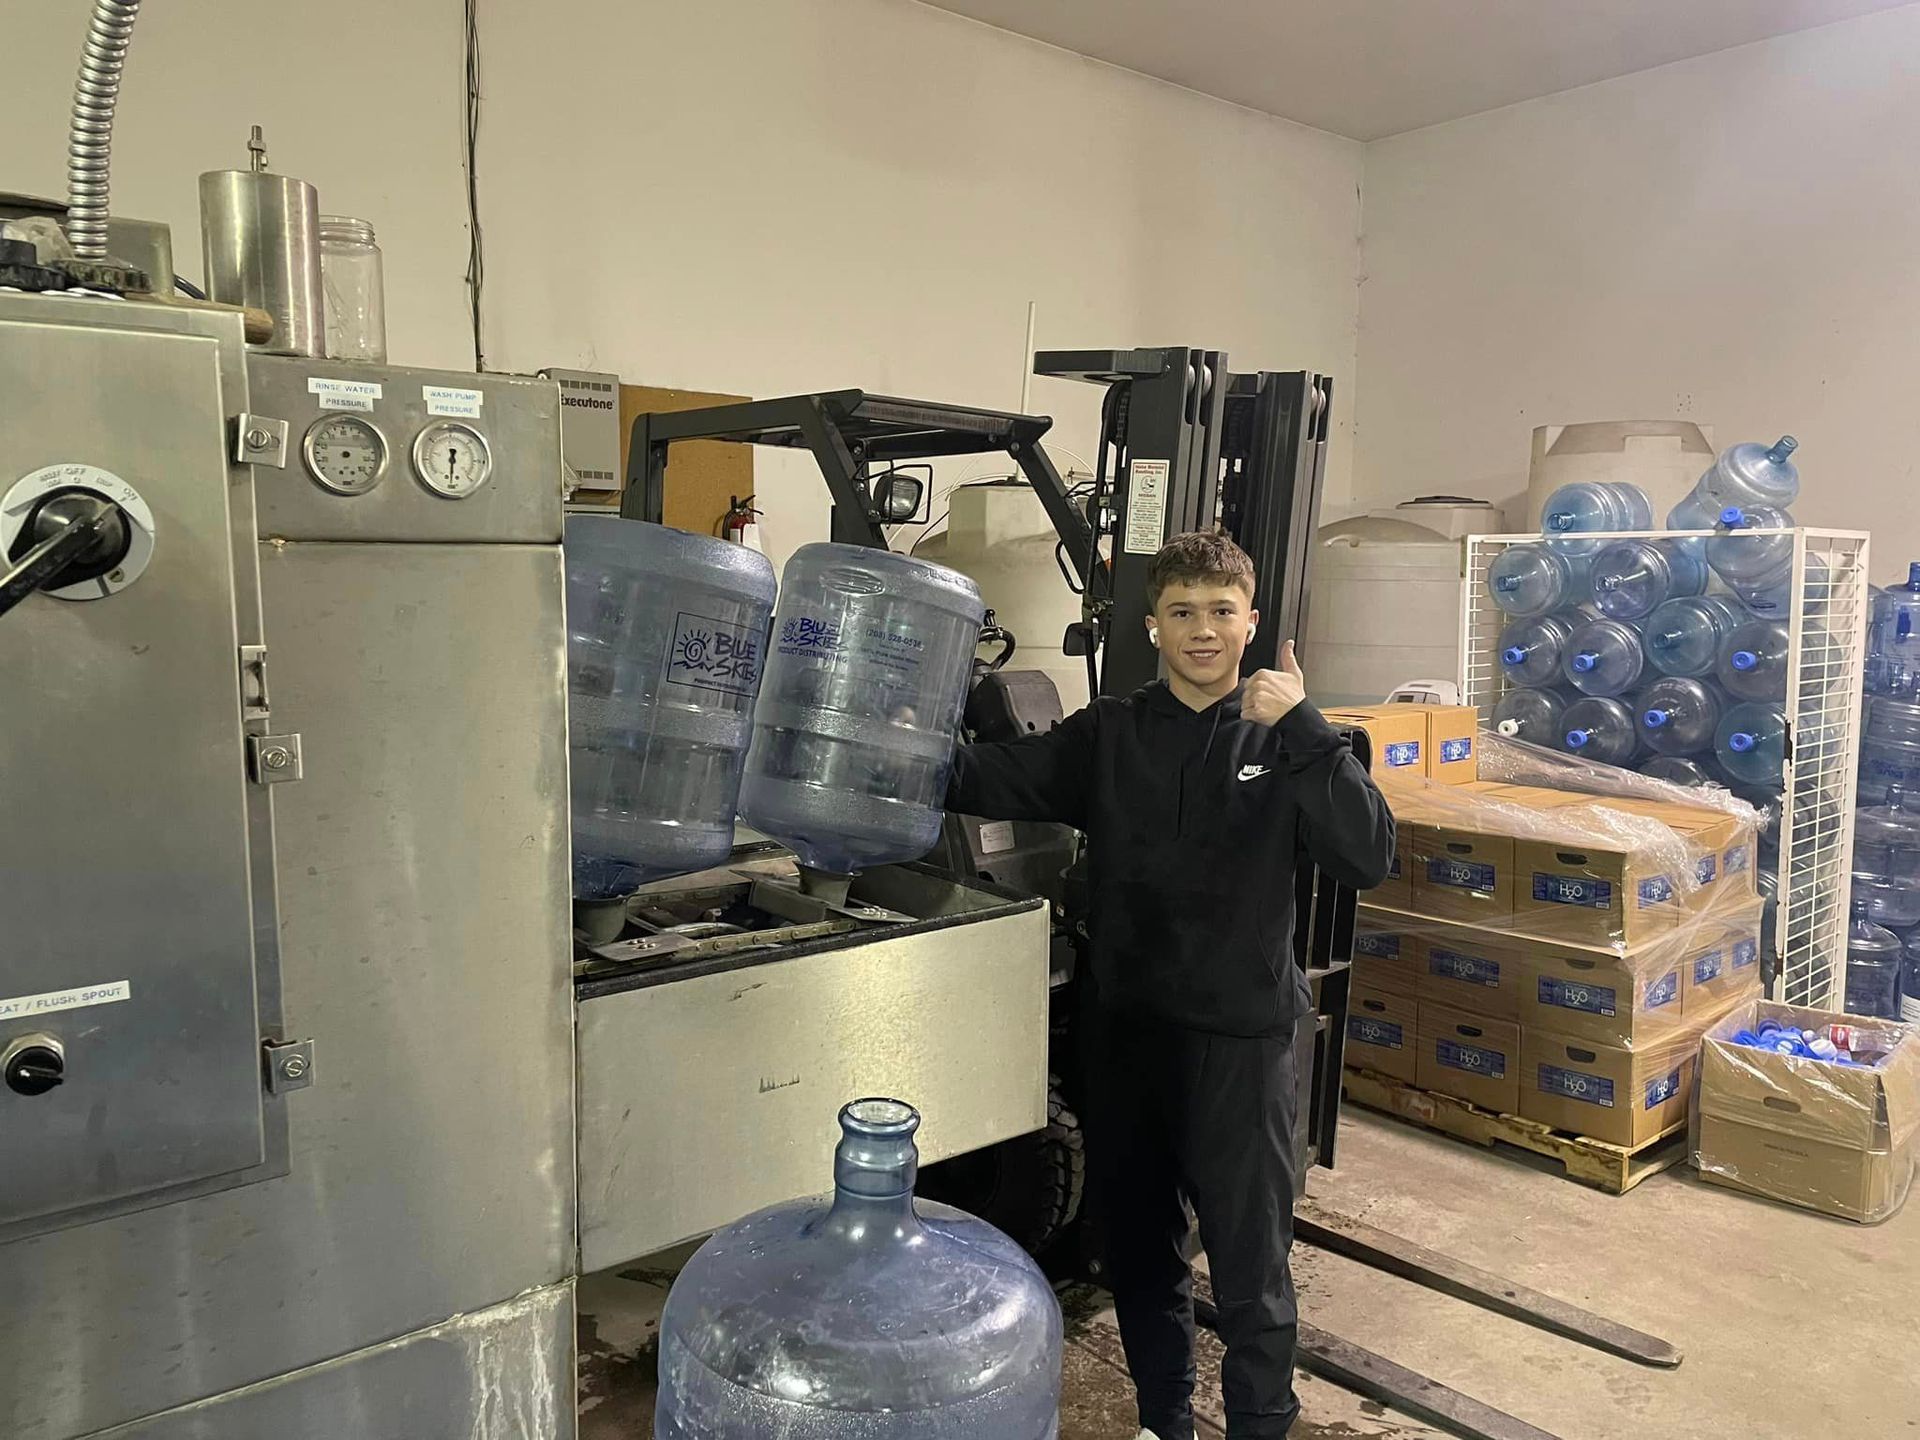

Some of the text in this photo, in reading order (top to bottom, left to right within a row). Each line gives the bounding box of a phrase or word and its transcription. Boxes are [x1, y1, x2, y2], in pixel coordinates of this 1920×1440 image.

[315, 382, 375, 395] RINSE WATER
[325, 397, 367, 408] PRESSURE
[561, 393, 613, 410] xecutone
[798, 616, 840, 637] BLUE
[714, 631, 757, 661] BLUE
[797, 632, 849, 653] SKIES
[713, 657, 757, 685] SKIES
[1242, 764, 1264, 775] NIKE
[1450, 866, 1471, 882] H2O
[1560, 883, 1583, 900] H2O
[1453, 960, 1475, 976] H2O
[37, 995, 77, 1008] FLUSH
[82, 987, 123, 1002] SPOUT
[1565, 988, 1588, 1005] H2O
[1361, 1024, 1381, 1040] H2O
[1460, 1049, 1481, 1066] H2O
[1564, 1077, 1587, 1094] H2O
[1657, 1080, 1668, 1096] H2O
